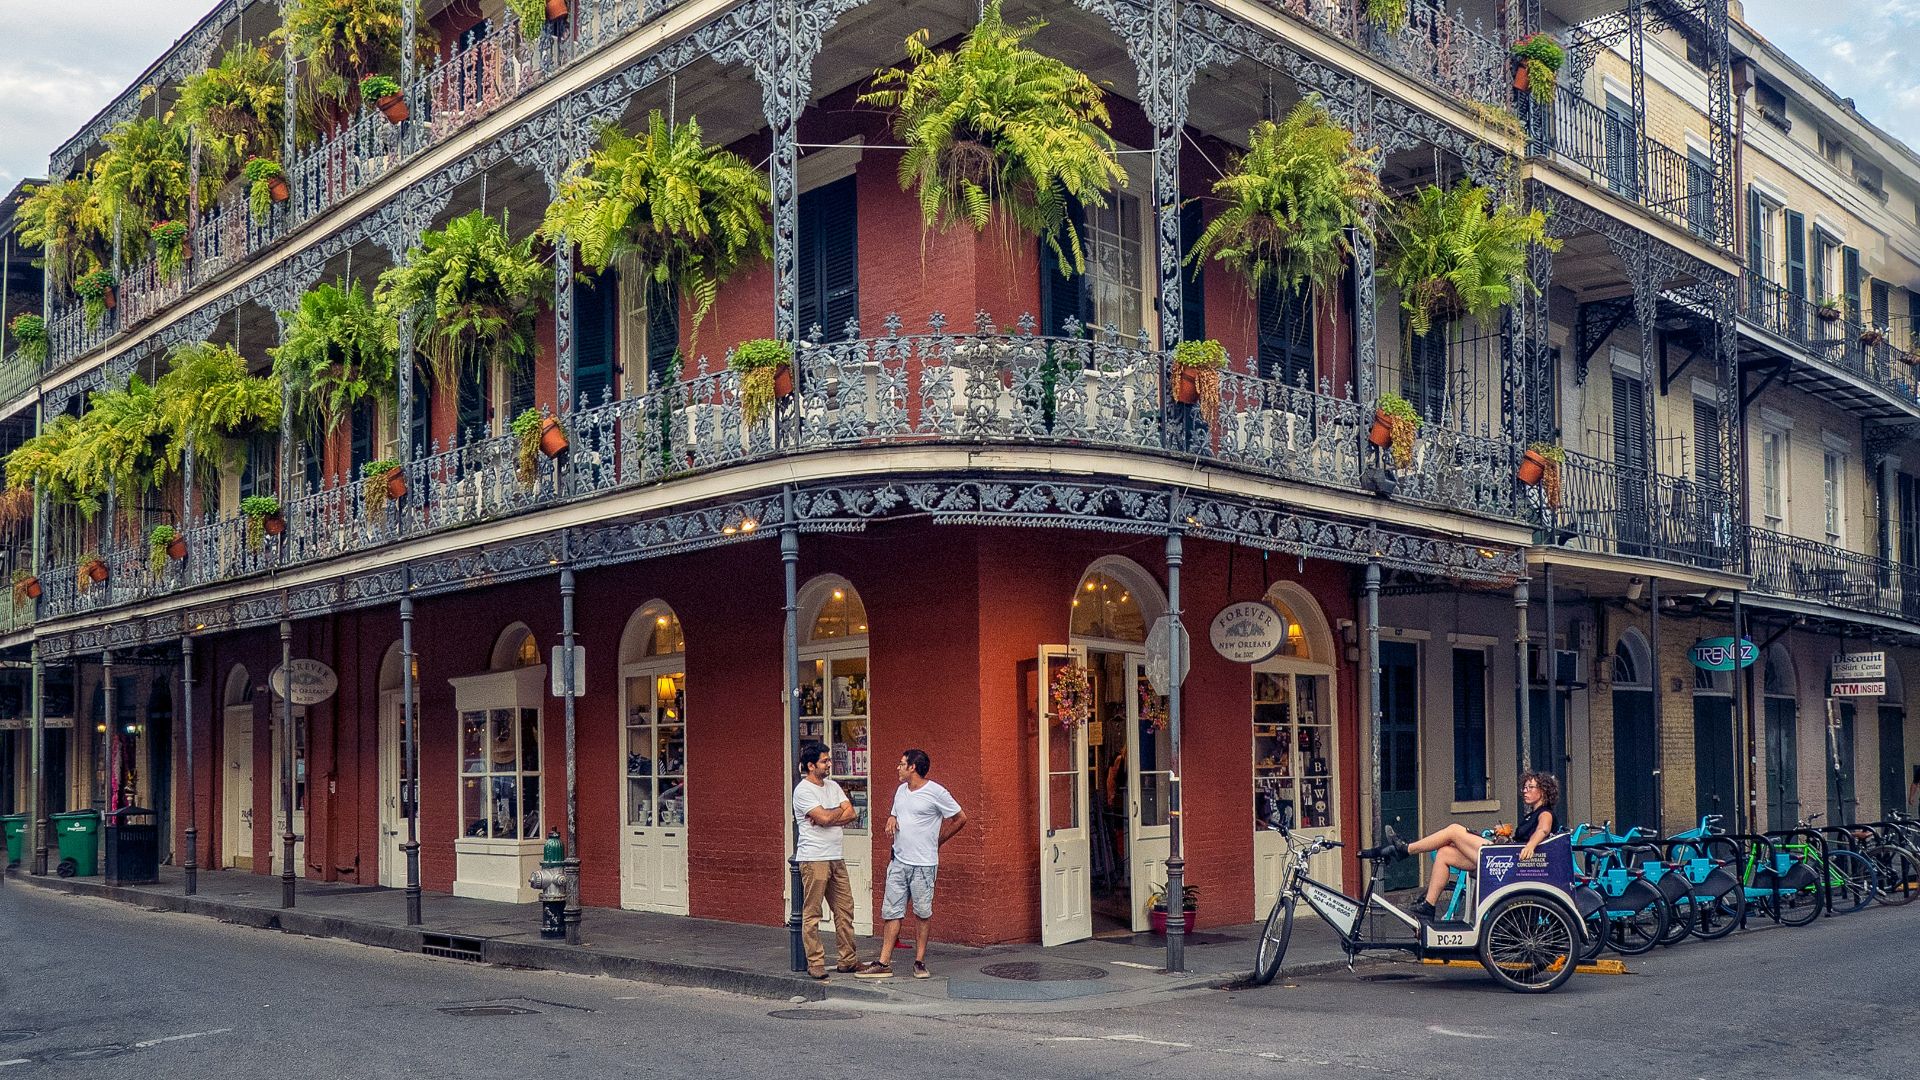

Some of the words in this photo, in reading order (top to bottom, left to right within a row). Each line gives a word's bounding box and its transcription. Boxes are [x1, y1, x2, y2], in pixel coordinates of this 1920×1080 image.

[1219, 607, 1272, 628] FOREVER
[1219, 642, 1235, 650] NEW
[1238, 640, 1271, 649] ORLEANS
[1834, 653, 1882, 664] Discount
[1833, 684, 1859, 695] ATM
[1860, 684, 1883, 693] INSIDE
[1486, 856, 1514, 869] Vintage
[1314, 889, 1328, 898] NEED
[1437, 934, 1463, 946] PC-22
